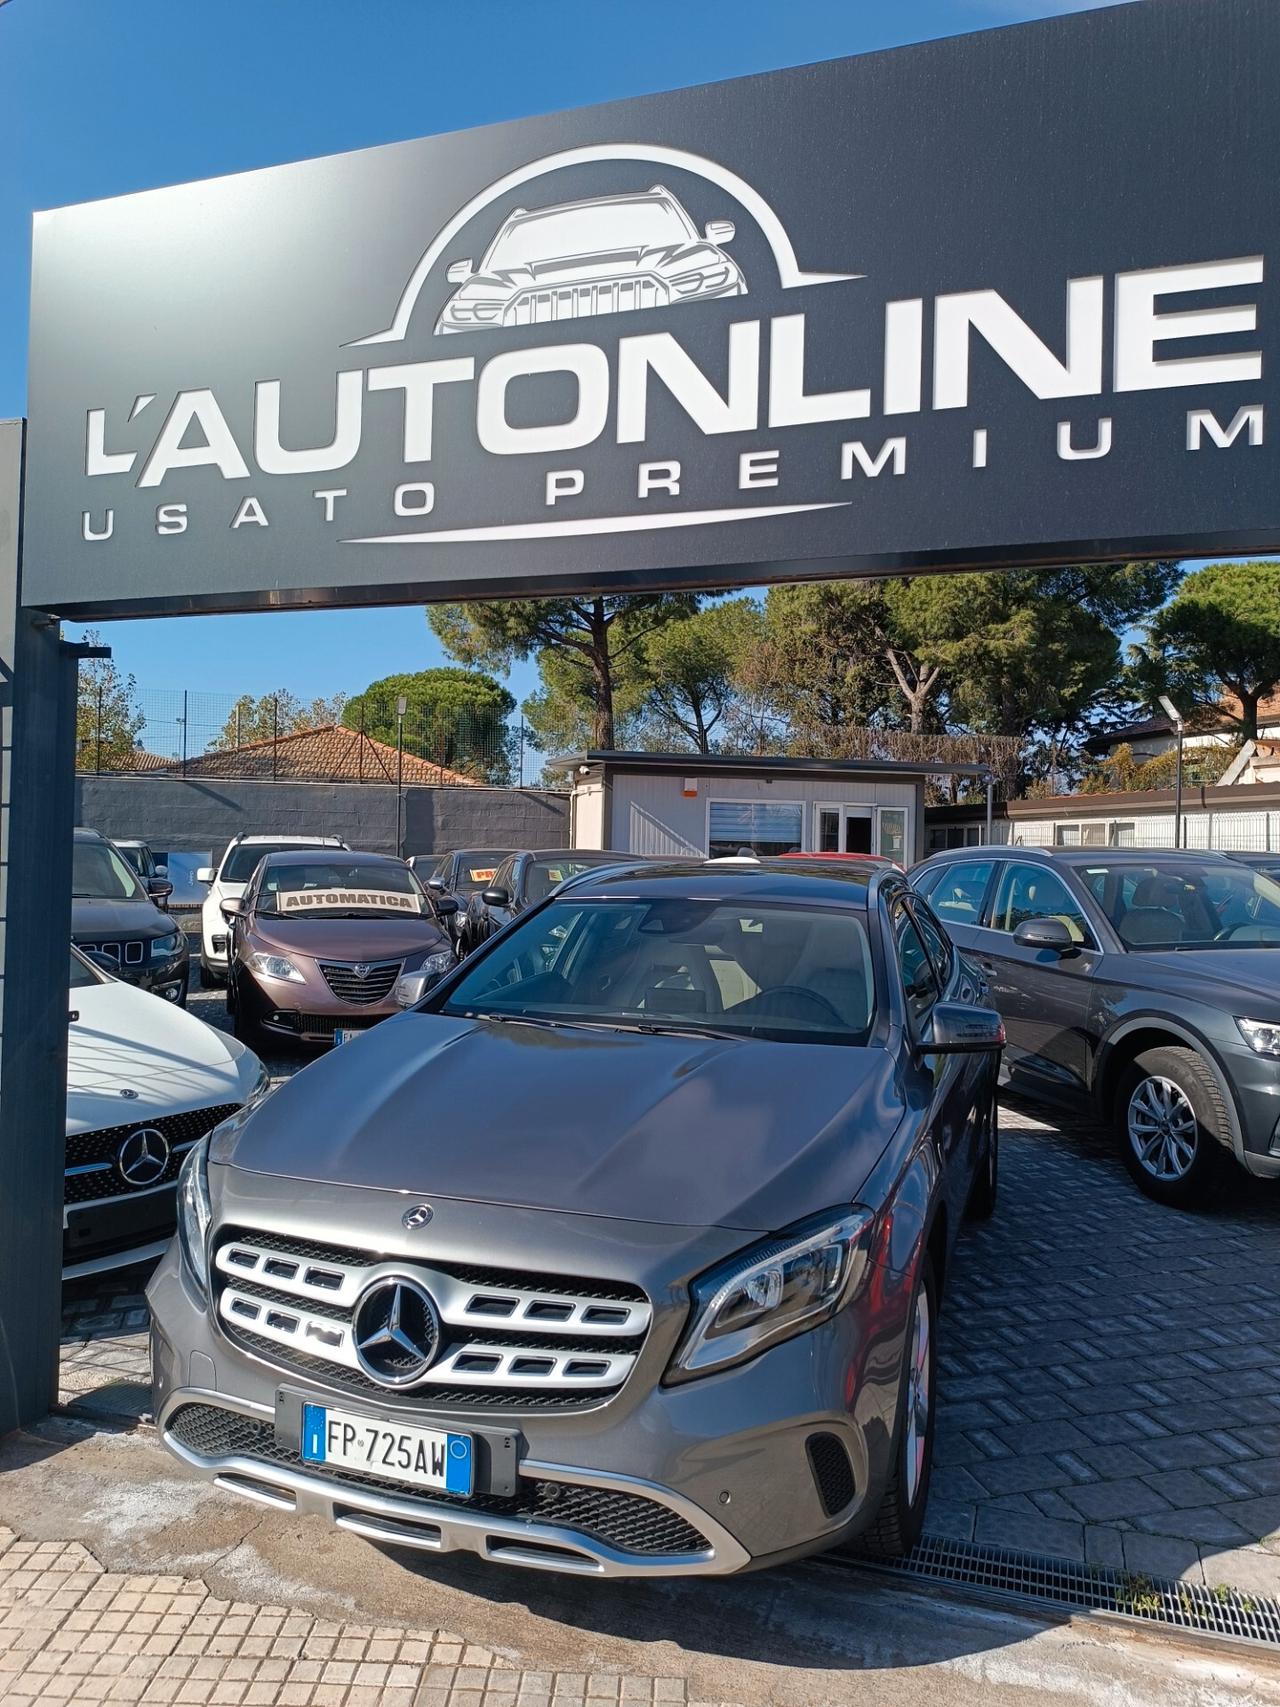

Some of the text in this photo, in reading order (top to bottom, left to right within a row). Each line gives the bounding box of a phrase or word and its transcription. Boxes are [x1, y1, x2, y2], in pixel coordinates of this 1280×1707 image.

[82, 405, 1264, 541] USATO PREMIUM
[286, 893, 412, 908] AUTOMATICA
[328, 1420, 446, 1477] FP 725AW
